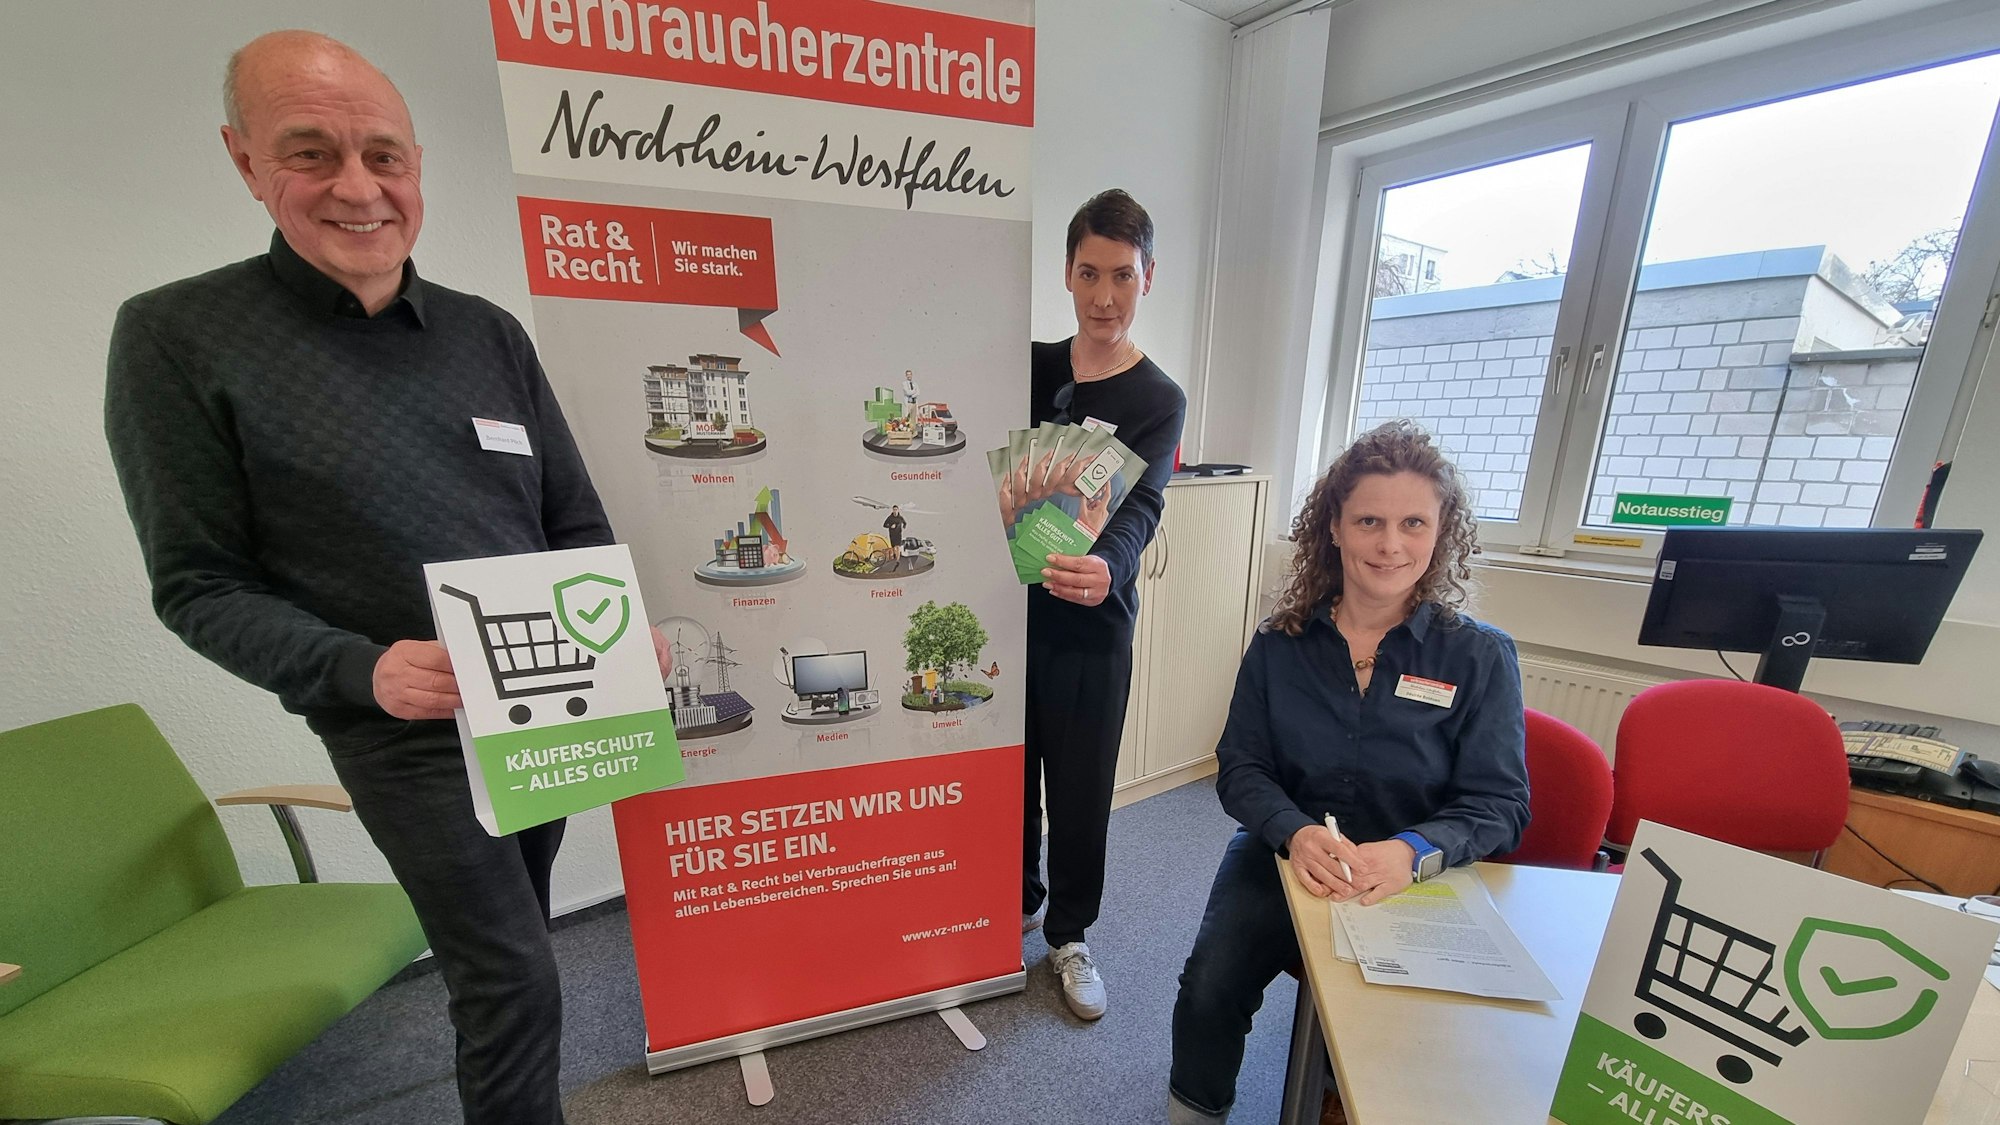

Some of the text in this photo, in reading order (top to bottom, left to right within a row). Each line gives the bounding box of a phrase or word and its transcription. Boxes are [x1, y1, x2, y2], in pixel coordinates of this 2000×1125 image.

[541, 90, 1015, 210] Nordrhein-Westfalen
[540, 213, 634, 251] Rat &
[672, 240, 758, 261] Wir machen
[544, 248, 644, 285] Recht
[674, 258, 743, 277] Sie stark.
[691, 473, 735, 485] Wohnen
[890, 469, 943, 482] Gesundheit
[1617, 502, 1725, 523] Notausstieg
[1035, 522, 1050, 537] ALLES
[1049, 532, 1063, 545] GUT?
[1038, 517, 1074, 546] KÄUFERSCHUTZ
[733, 596, 776, 608] Finanzen
[870, 588, 903, 600] Freizeit
[931, 718, 963, 730] Umwelt
[816, 731, 849, 743] Medien
[505, 731, 656, 773] KÄUFERSCHUTZ
[681, 746, 717, 760] Energie
[529, 765, 589, 792] ALLES
[592, 756, 639, 779] GUT?
[665, 782, 964, 846] HIER SETZEN WIR UNS
[669, 831, 837, 878] FÜR SIE EIN.
[673, 849, 945, 902] Mit Rat & Recht bei Verbraucherfragen aus
[675, 860, 957, 919] allen Lebensbereichen. Sprechen Sie uns an!
[902, 916, 990, 943] www.vz-nrw.de
